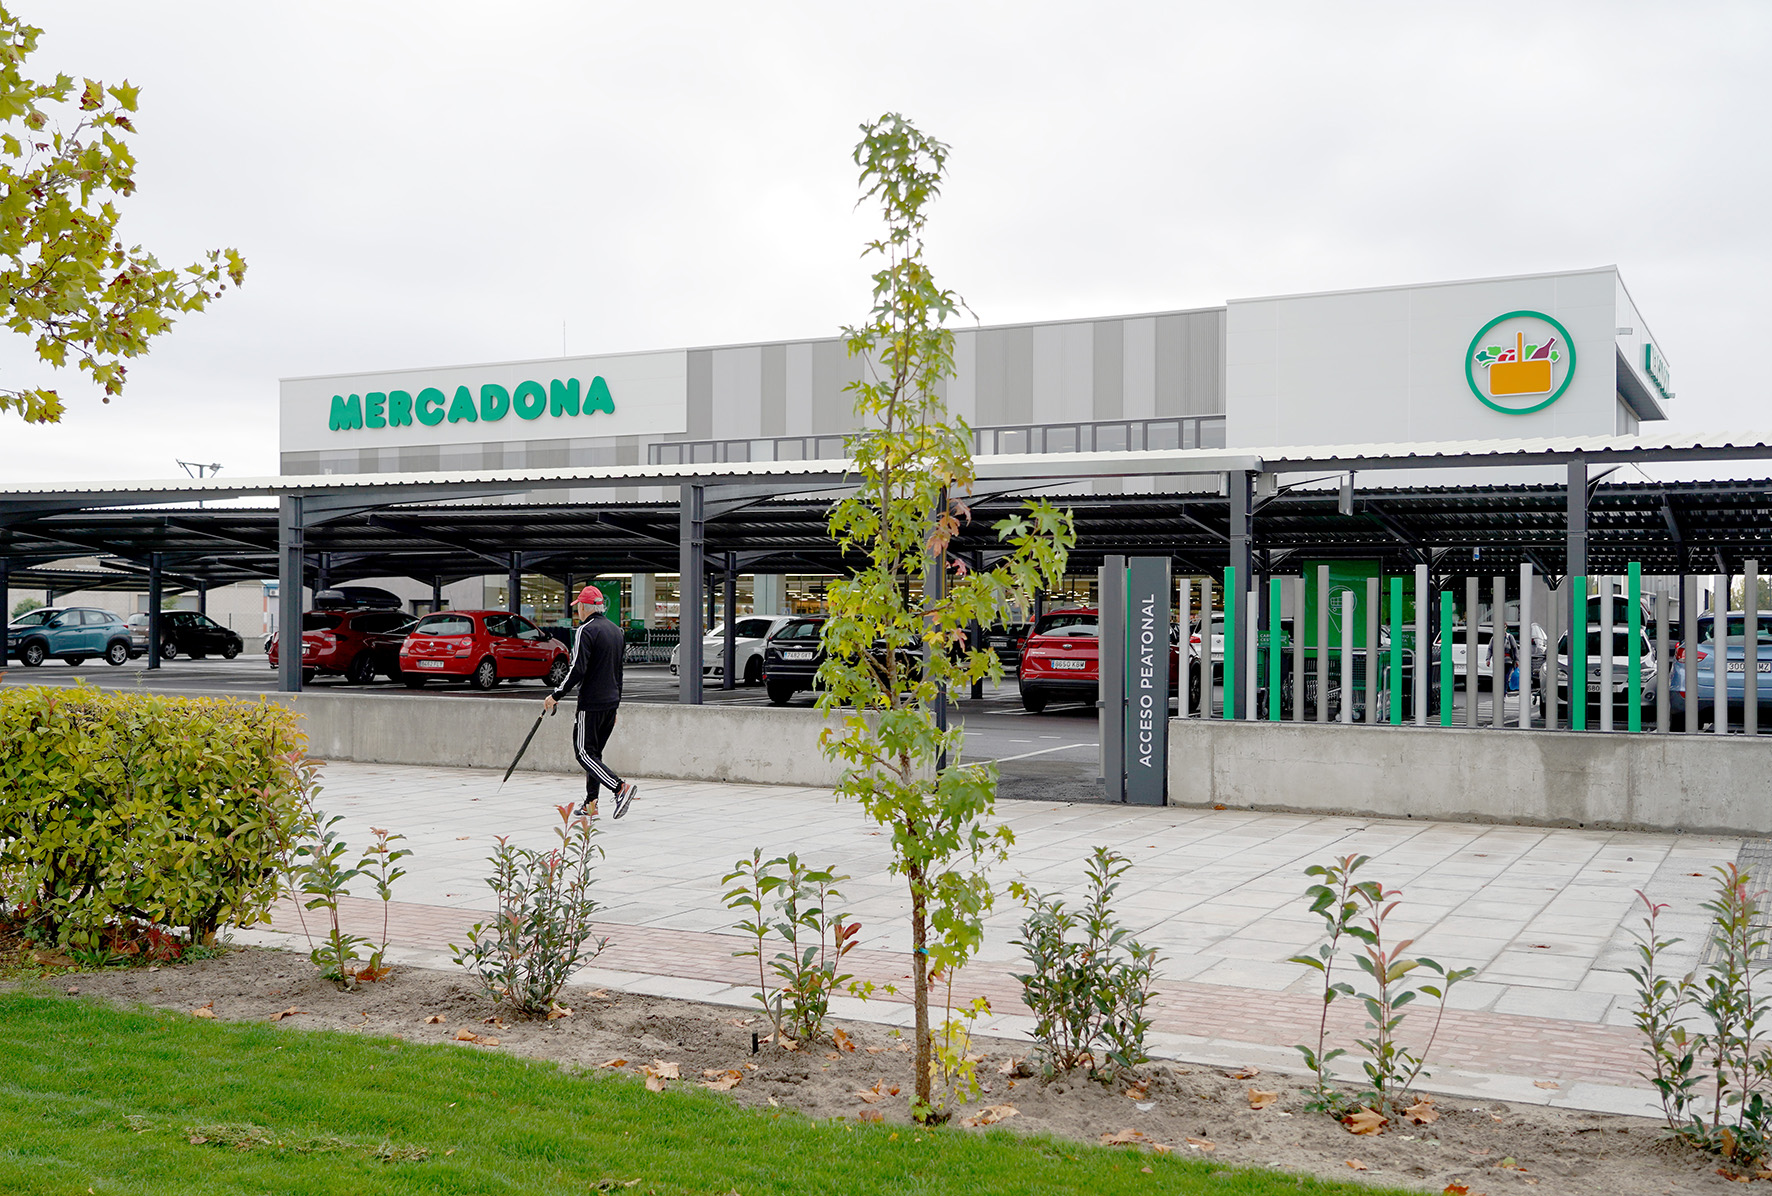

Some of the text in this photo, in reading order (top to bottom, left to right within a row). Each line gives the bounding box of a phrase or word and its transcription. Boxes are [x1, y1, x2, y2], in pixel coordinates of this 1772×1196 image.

[329, 375, 616, 432] MERCADONA
[1139, 593, 1155, 768] ACCESO PEATONAL
